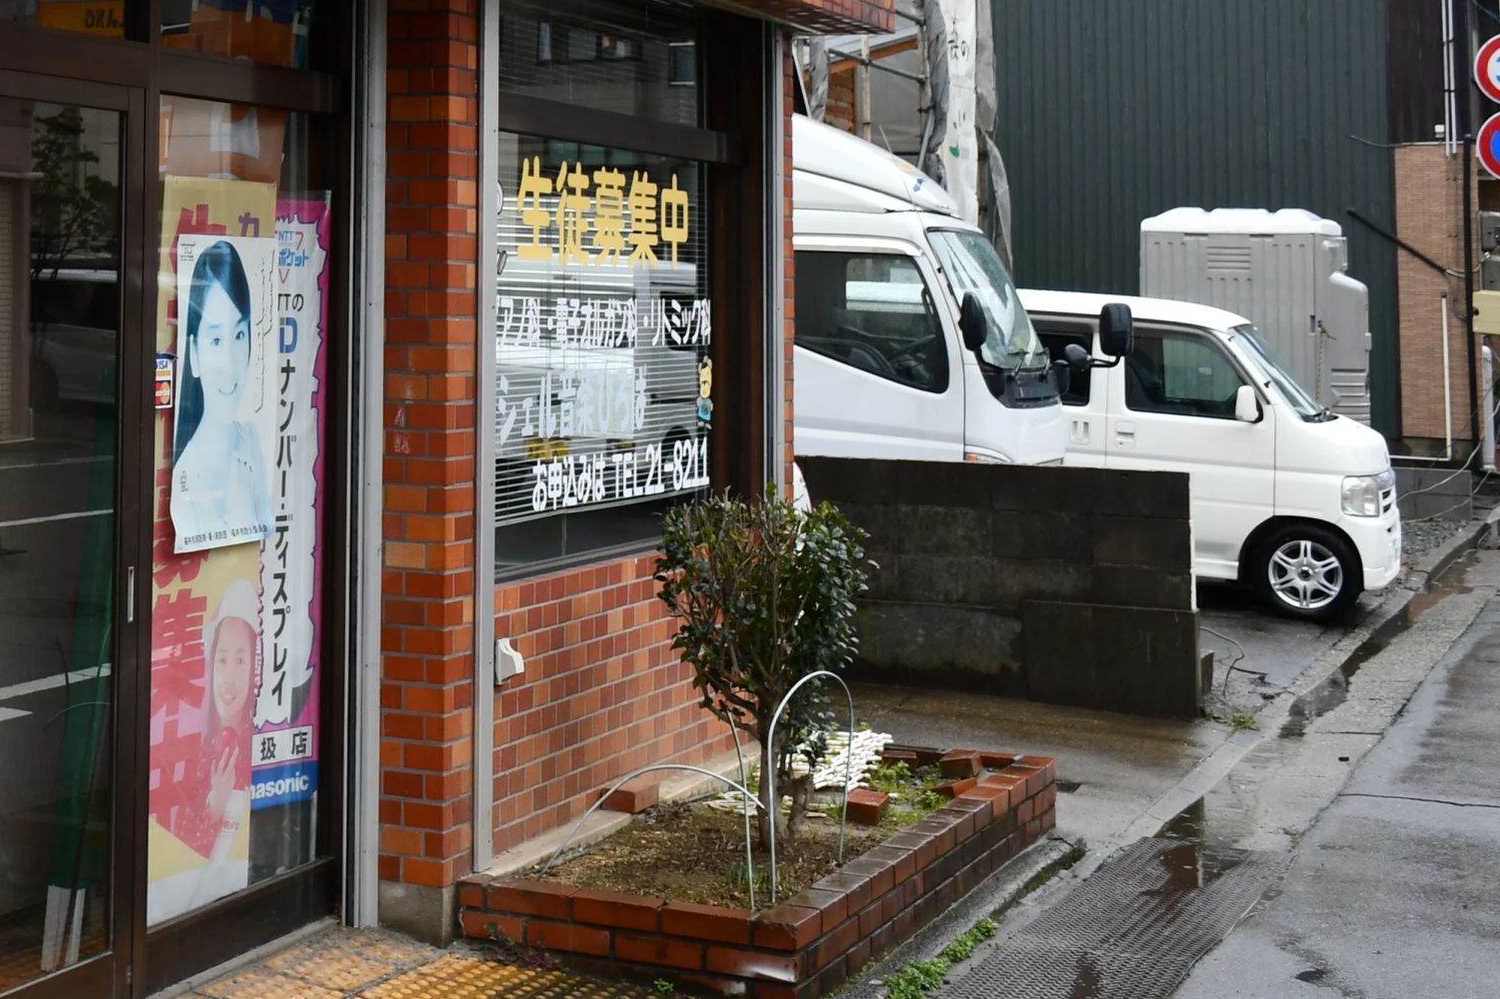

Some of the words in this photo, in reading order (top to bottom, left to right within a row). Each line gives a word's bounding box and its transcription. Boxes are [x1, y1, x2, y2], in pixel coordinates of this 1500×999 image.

[516, 155, 689, 270] 生徒募集中
[532, 453, 606, 512] お申込みは
